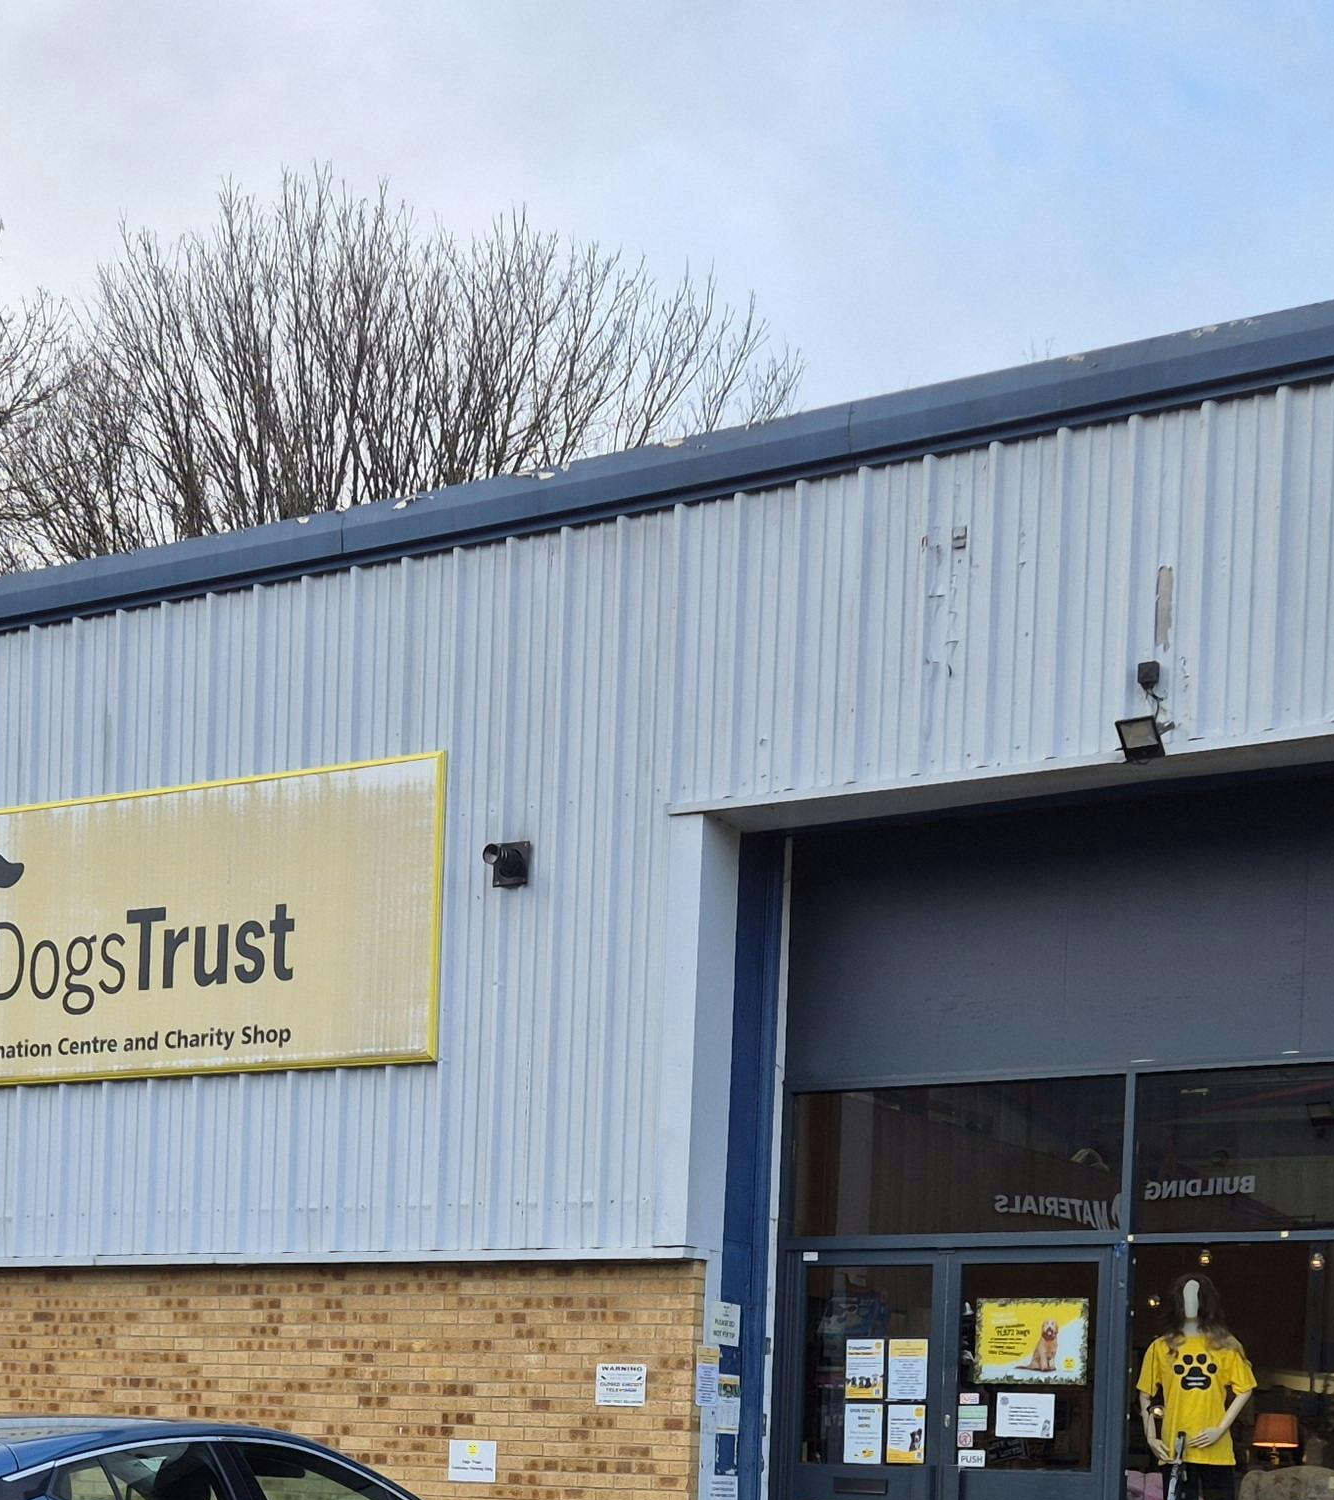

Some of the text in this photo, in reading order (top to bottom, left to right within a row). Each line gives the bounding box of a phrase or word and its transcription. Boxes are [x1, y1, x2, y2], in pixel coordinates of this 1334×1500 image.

[58, 1036, 117, 1056] Centre
[123, 1031, 159, 1052] and
[164, 1027, 235, 1051] Charity
[241, 1024, 291, 1048] Shop
[960, 1455, 983, 1464] PUSH
